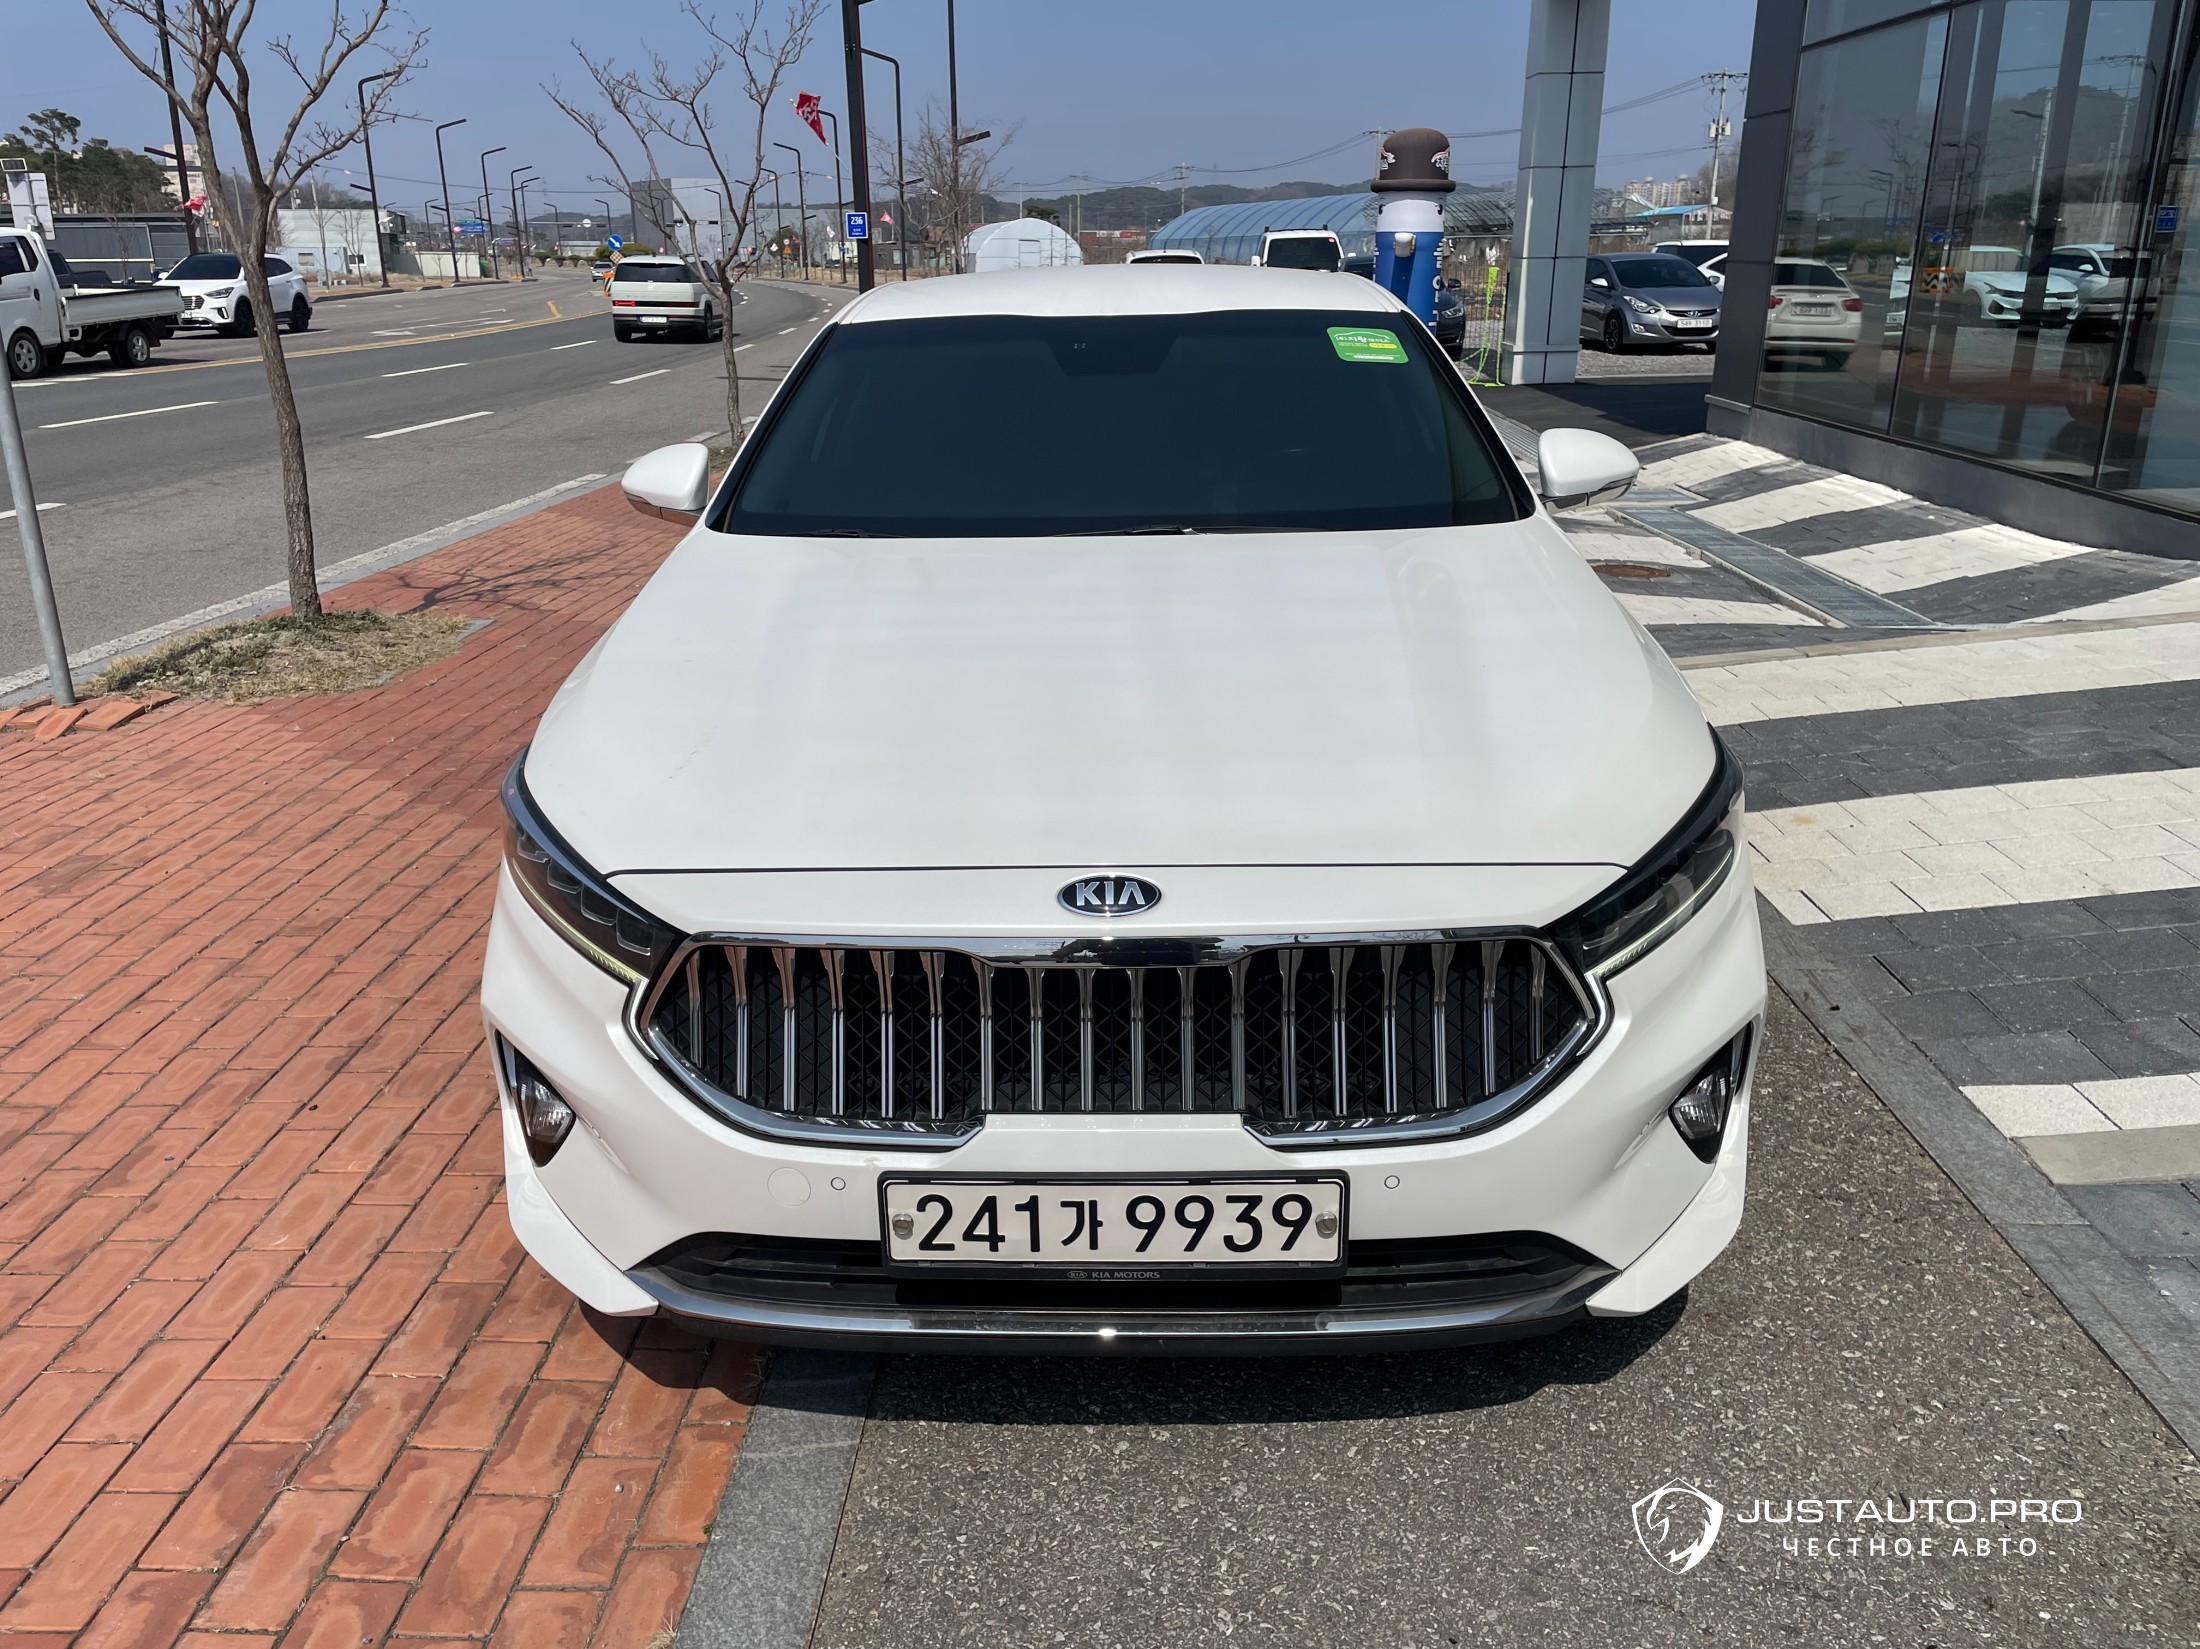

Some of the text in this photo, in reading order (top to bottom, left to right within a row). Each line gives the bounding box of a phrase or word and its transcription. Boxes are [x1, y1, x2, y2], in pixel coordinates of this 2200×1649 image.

[851, 216, 863, 224] 236
[1075, 880, 1146, 906] KIA
[1125, 1194, 1314, 1252] 9939
[1091, 1271, 1111, 1279] KIA
[1113, 1271, 1160, 1279] MOTORS
